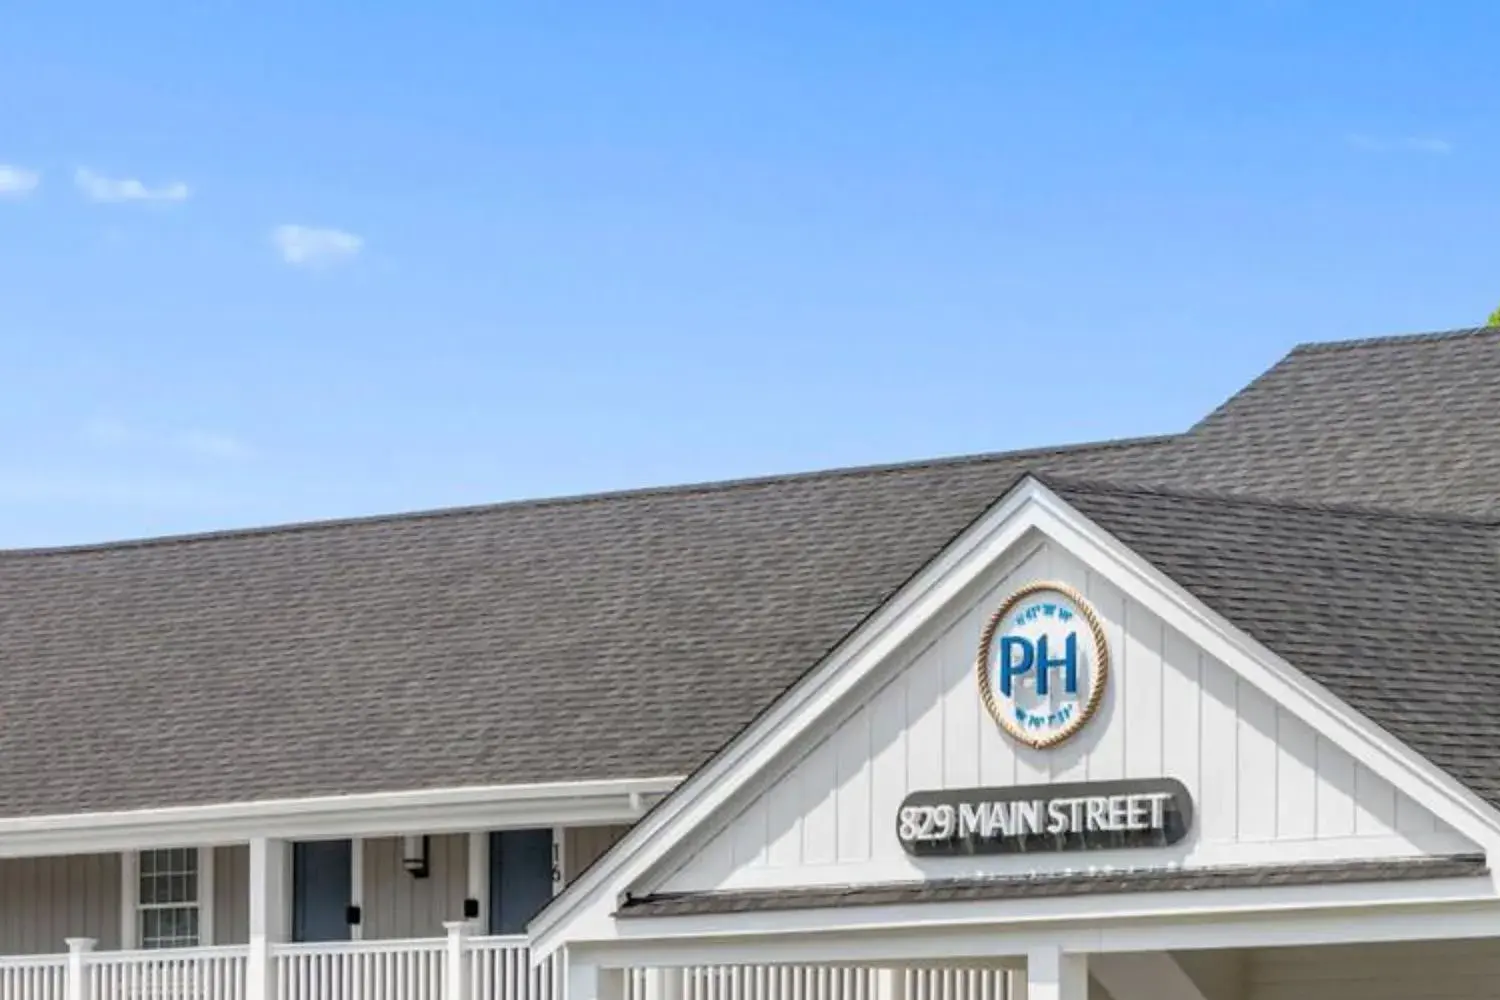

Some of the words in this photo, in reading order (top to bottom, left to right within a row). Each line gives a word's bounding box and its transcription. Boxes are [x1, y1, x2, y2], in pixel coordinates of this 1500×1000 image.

[1000, 631, 1077, 697] PH
[899, 805, 957, 841] 829
[958, 799, 1045, 838] MAIN
[1047, 793, 1170, 833] STREET
